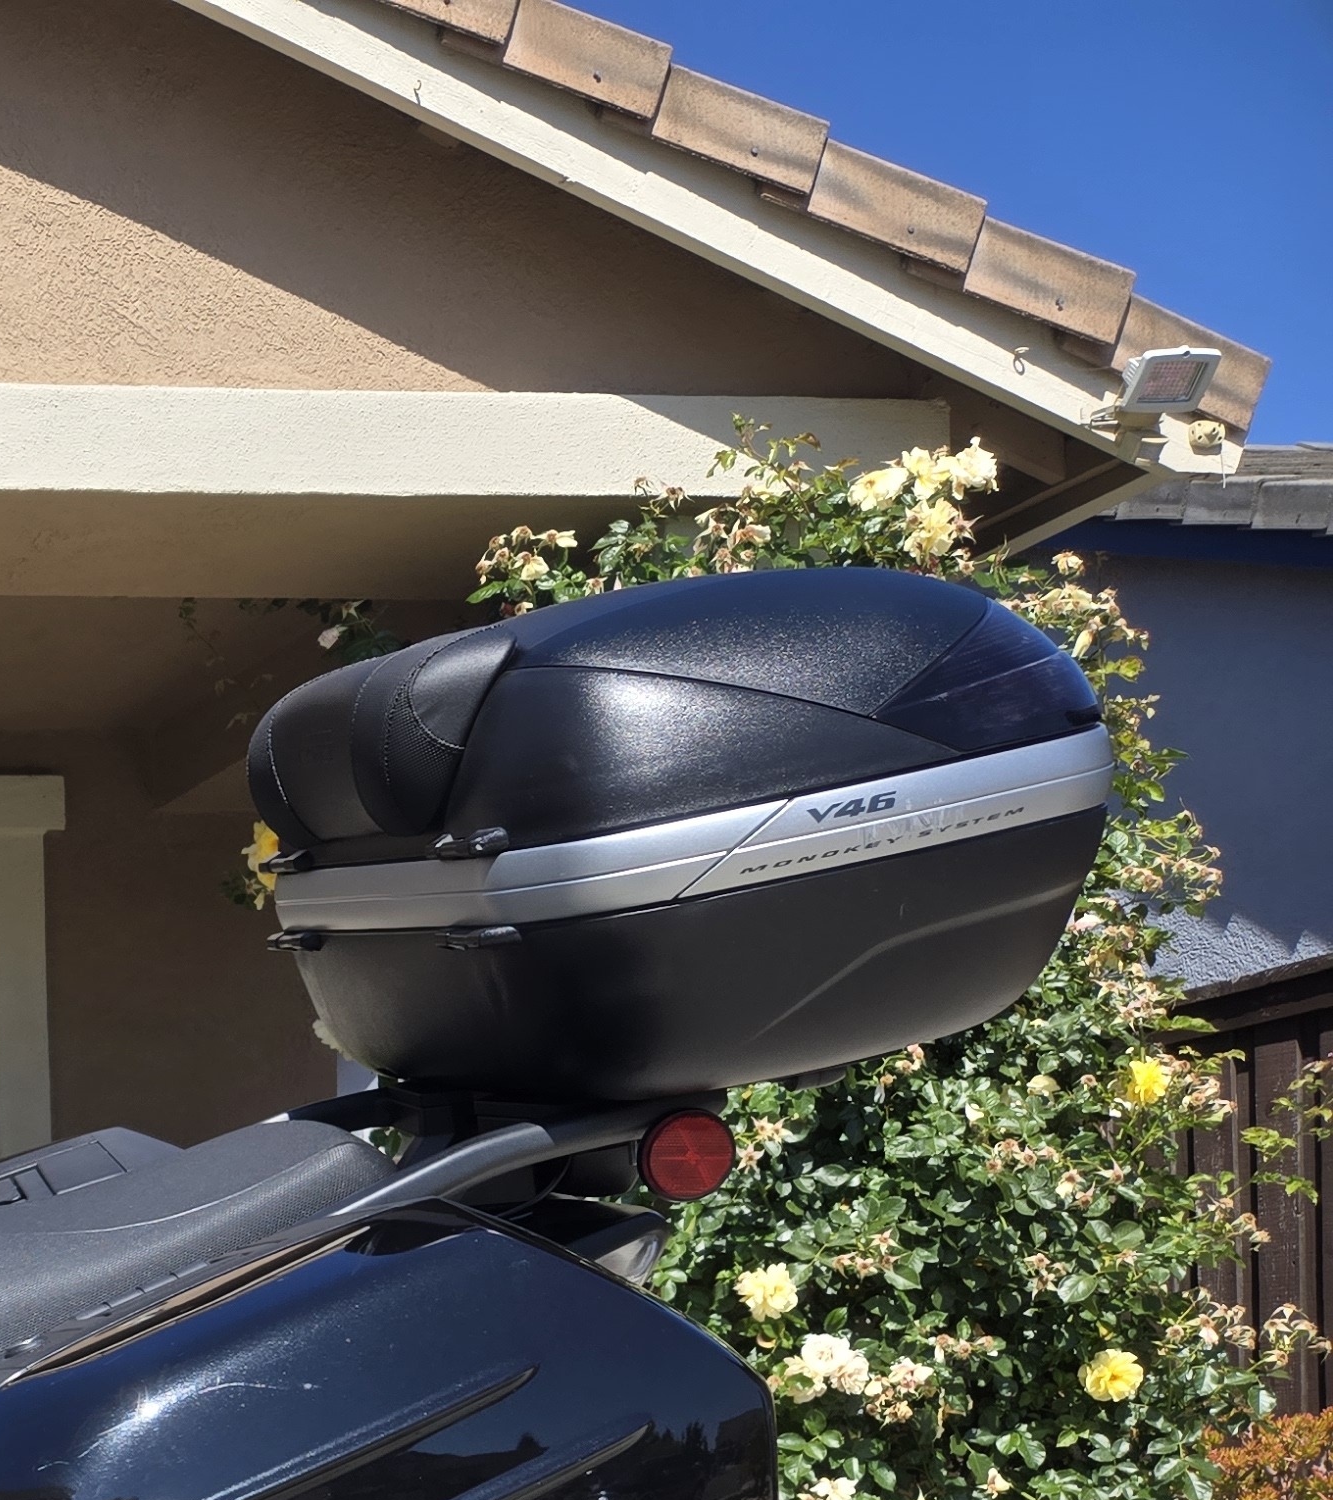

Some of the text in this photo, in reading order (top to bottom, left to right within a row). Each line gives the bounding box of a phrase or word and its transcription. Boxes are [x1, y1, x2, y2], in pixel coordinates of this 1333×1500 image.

[806, 790, 897, 824] V46
[738, 806, 1026, 875] MONOKEY SYSTEM
